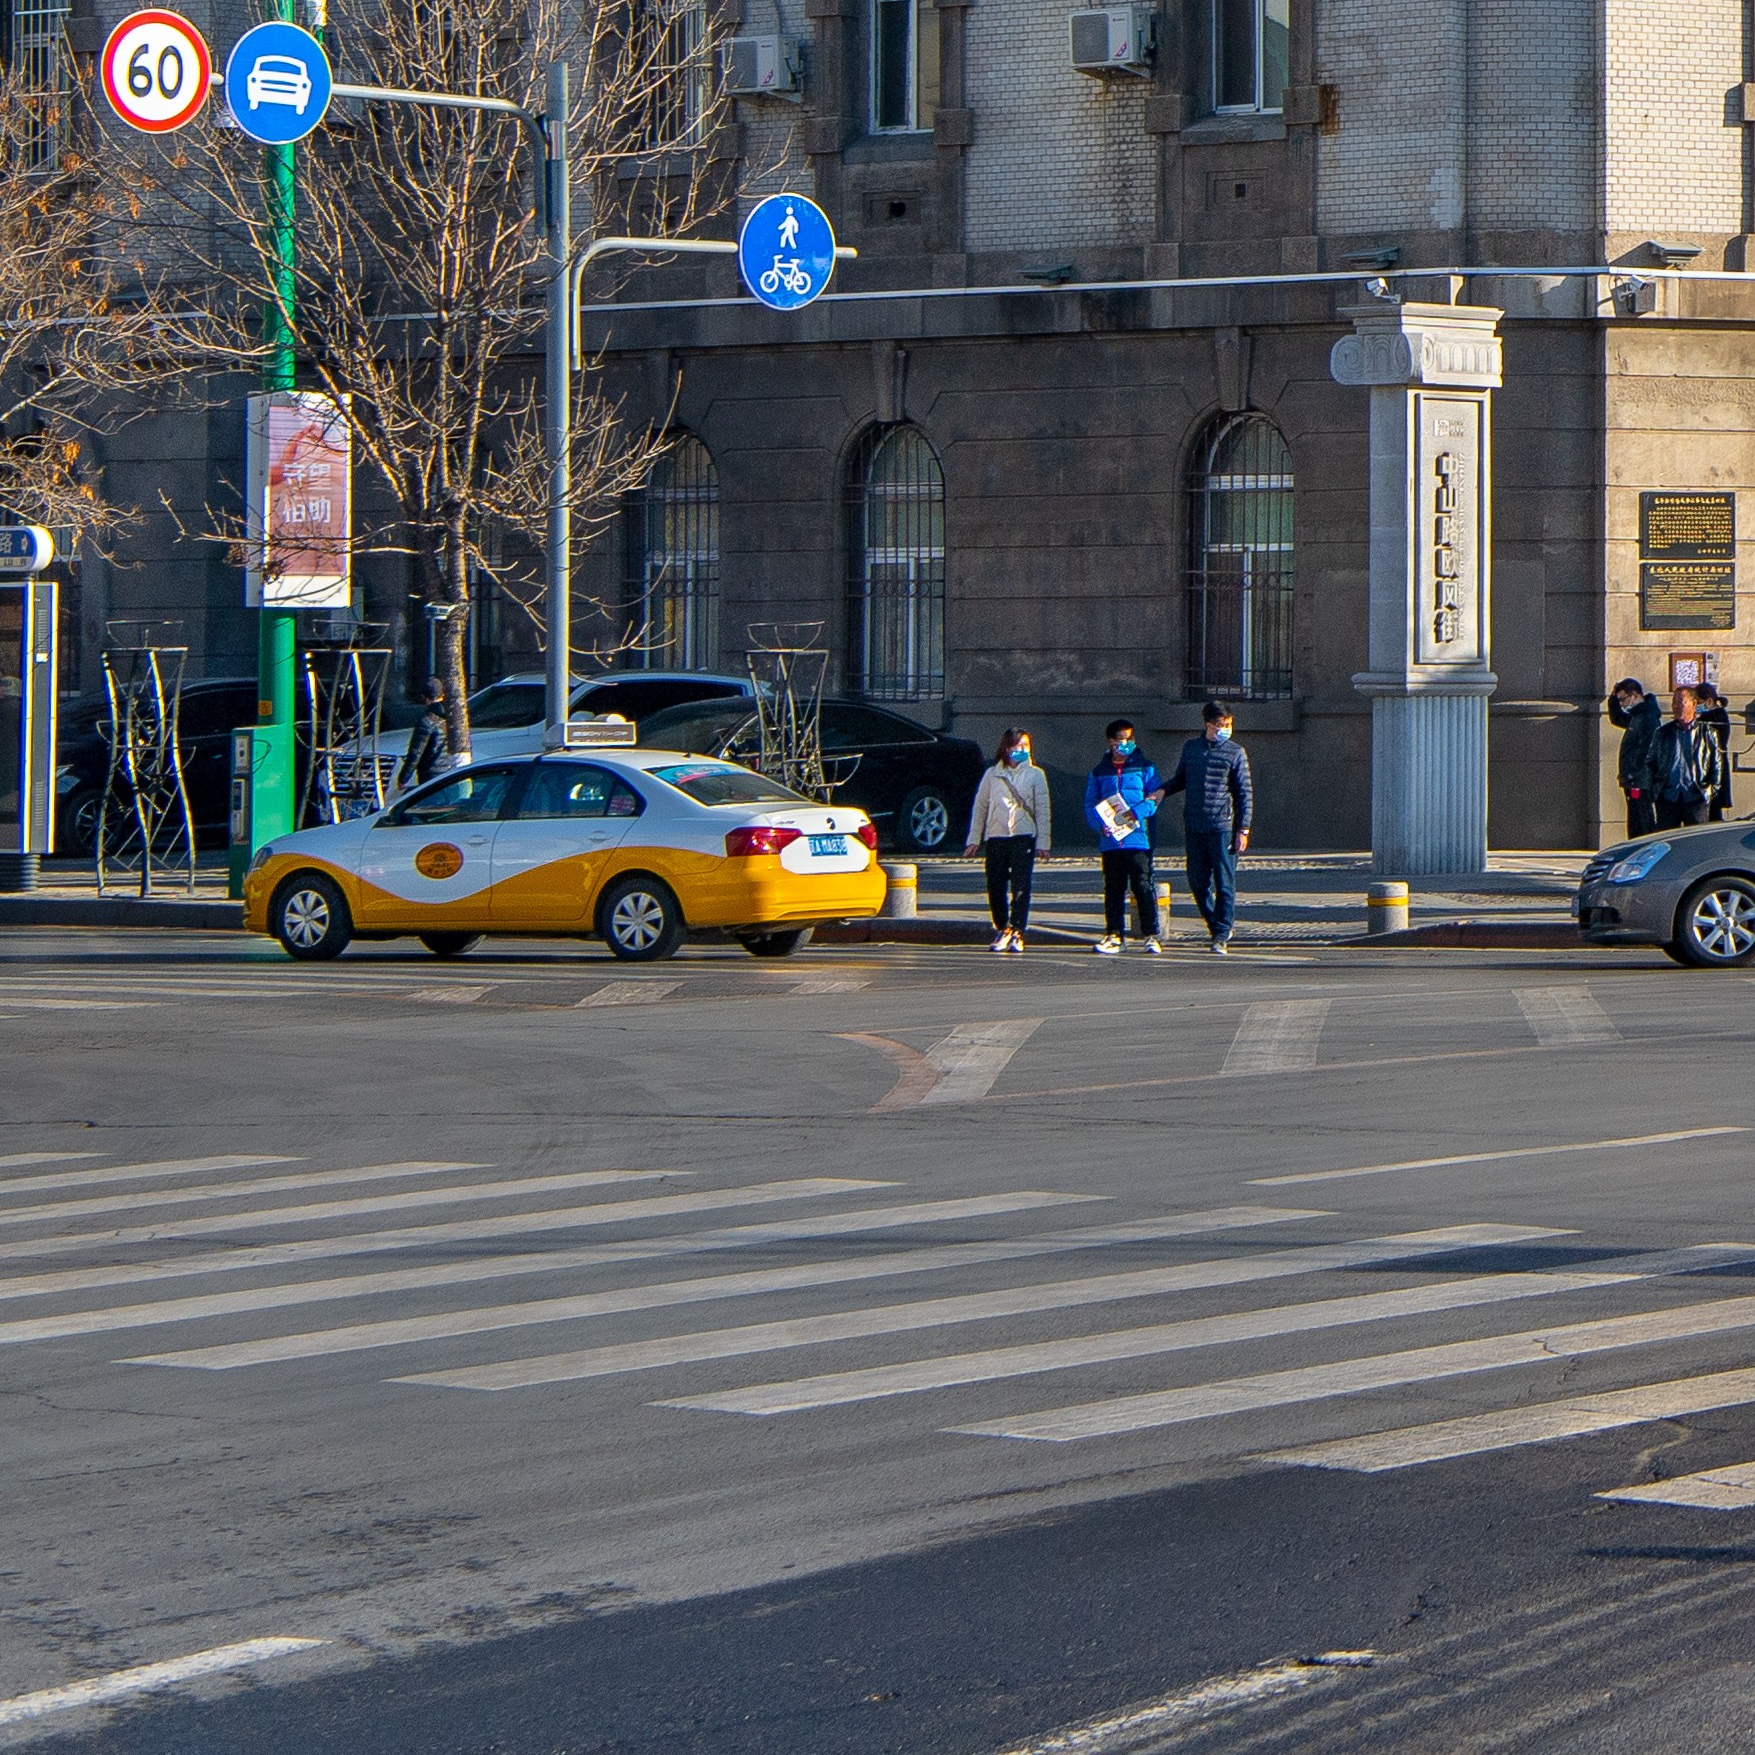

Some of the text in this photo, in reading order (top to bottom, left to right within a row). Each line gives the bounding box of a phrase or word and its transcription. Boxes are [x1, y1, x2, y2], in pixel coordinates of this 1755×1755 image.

[128, 43, 184, 100] 60
[1437, 451, 1459, 643] 中山路欧风街
